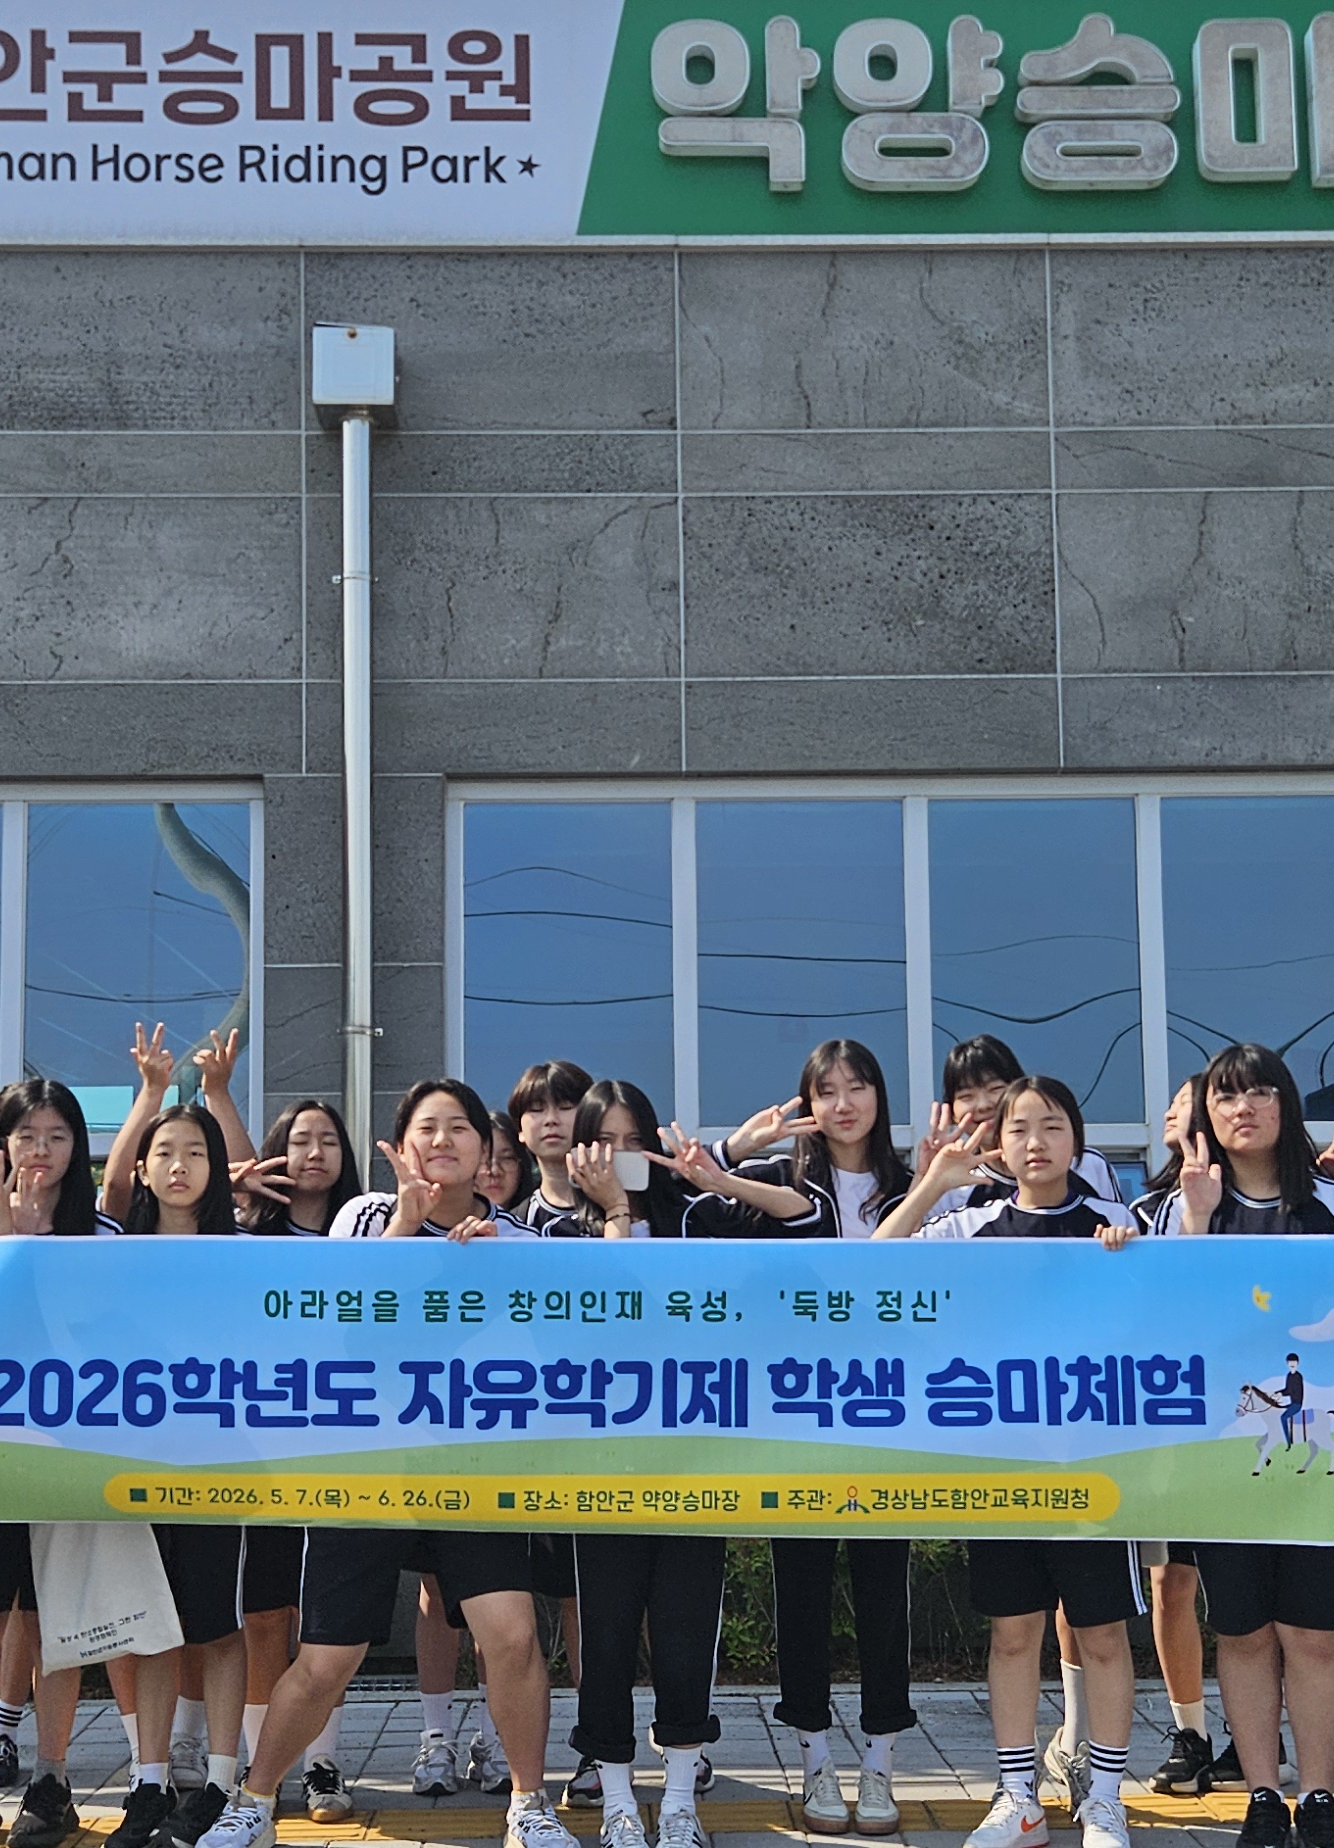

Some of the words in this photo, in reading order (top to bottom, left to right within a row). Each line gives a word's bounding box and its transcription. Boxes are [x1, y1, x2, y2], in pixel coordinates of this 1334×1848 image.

[91, 143, 225, 184] Horse
[239, 143, 387, 196] Riding
[401, 145, 508, 184] Park
[263, 1289, 401, 1324] 아라얼을
[422, 1289, 487, 1324] 품은
[507, 1289, 644, 1323] 창의인재
[664, 1289, 744, 1324] 육성,
[875, 1289, 953, 1324] 정신'
[397, 1356, 749, 1431] 자유학기제
[766, 1355, 907, 1429] 학생
[924, 1352, 1208, 1428] 승마체험
[154, 1486, 201, 1507] 기간:
[207, 1487, 264, 1506] 2026.
[270, 1488, 289, 1506] 5.
[295, 1487, 351, 1509] 7.(목)
[378, 1488, 397, 1507] 6.
[402, 1488, 471, 1511] 26.(금)
[523, 1489, 570, 1512] 장소:
[576, 1489, 635, 1513] 함안군
[786, 1489, 832, 1511] 주관:
[870, 1487, 1090, 1512] 경상남도함안교육지원청
